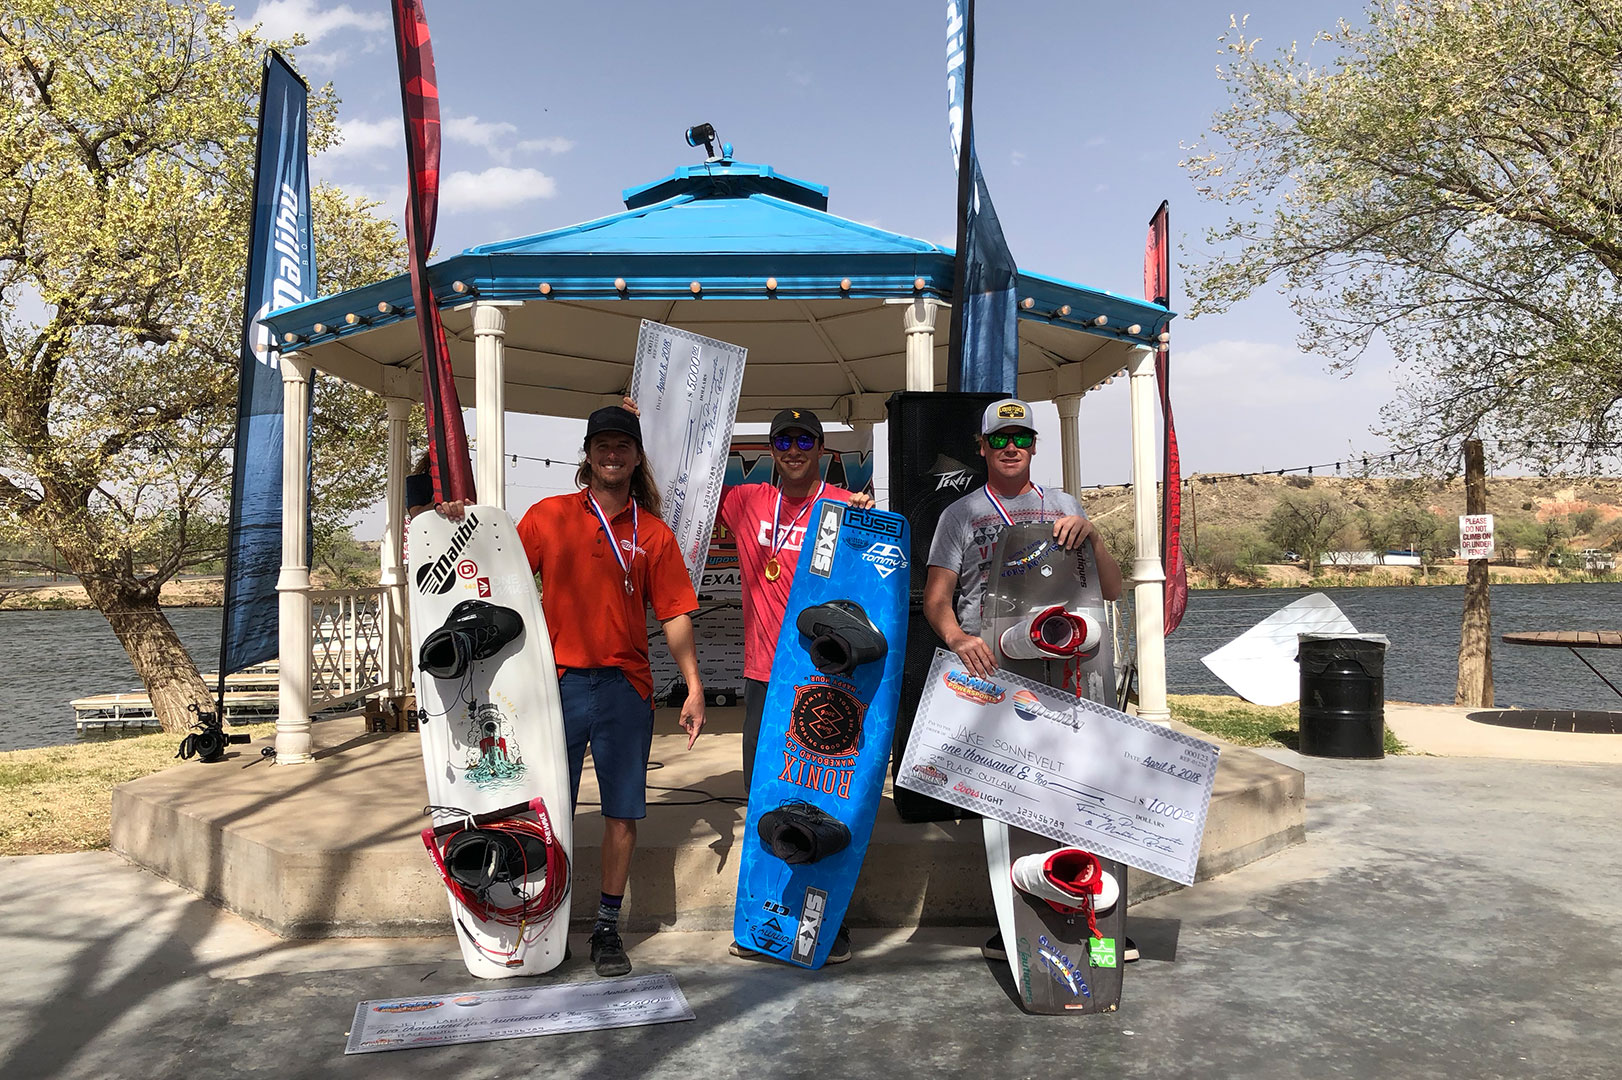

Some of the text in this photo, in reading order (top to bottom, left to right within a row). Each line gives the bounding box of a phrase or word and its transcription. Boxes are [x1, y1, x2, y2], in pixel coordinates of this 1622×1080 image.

[656, 370, 666, 394] April
[661, 338, 672, 361] 2018
[661, 479, 675, 519] ARROLL
[703, 466, 717, 509] 123456789
[671, 500, 682, 534] usand
[849, 513, 898, 534] FUSE
[814, 510, 838, 571] AXIS
[862, 553, 908, 569] TOMMY'S
[1076, 543, 1088, 589] autiques
[810, 675, 831, 683] HOUR
[833, 680, 857, 693] HAPPY
[947, 668, 1007, 697] FAMILY
[947, 682, 998, 702] POWERSPORTS
[800, 750, 856, 767] WAKEBOARD
[941, 743, 961, 755] one
[963, 748, 1018, 775] thousand
[1017, 766, 1031, 780] &
[951, 724, 1065, 773] JAKE SONNEVELT
[778, 751, 855, 799] RONIX
[946, 760, 974, 776] PLACE
[978, 772, 1017, 793] OUTLAW
[1143, 756, 1168, 771] April
[1178, 768, 1202, 783] 2018
[954, 781, 1004, 807] Coors LIGHT
[1139, 798, 1145, 806] $
[1016, 807, 1065, 829] 123456789
[1135, 814, 1165, 829] DOLLARS
[798, 893, 823, 957] AXIS
[1039, 935, 1074, 969] SLALOM
[1072, 970, 1091, 998] SHOP
